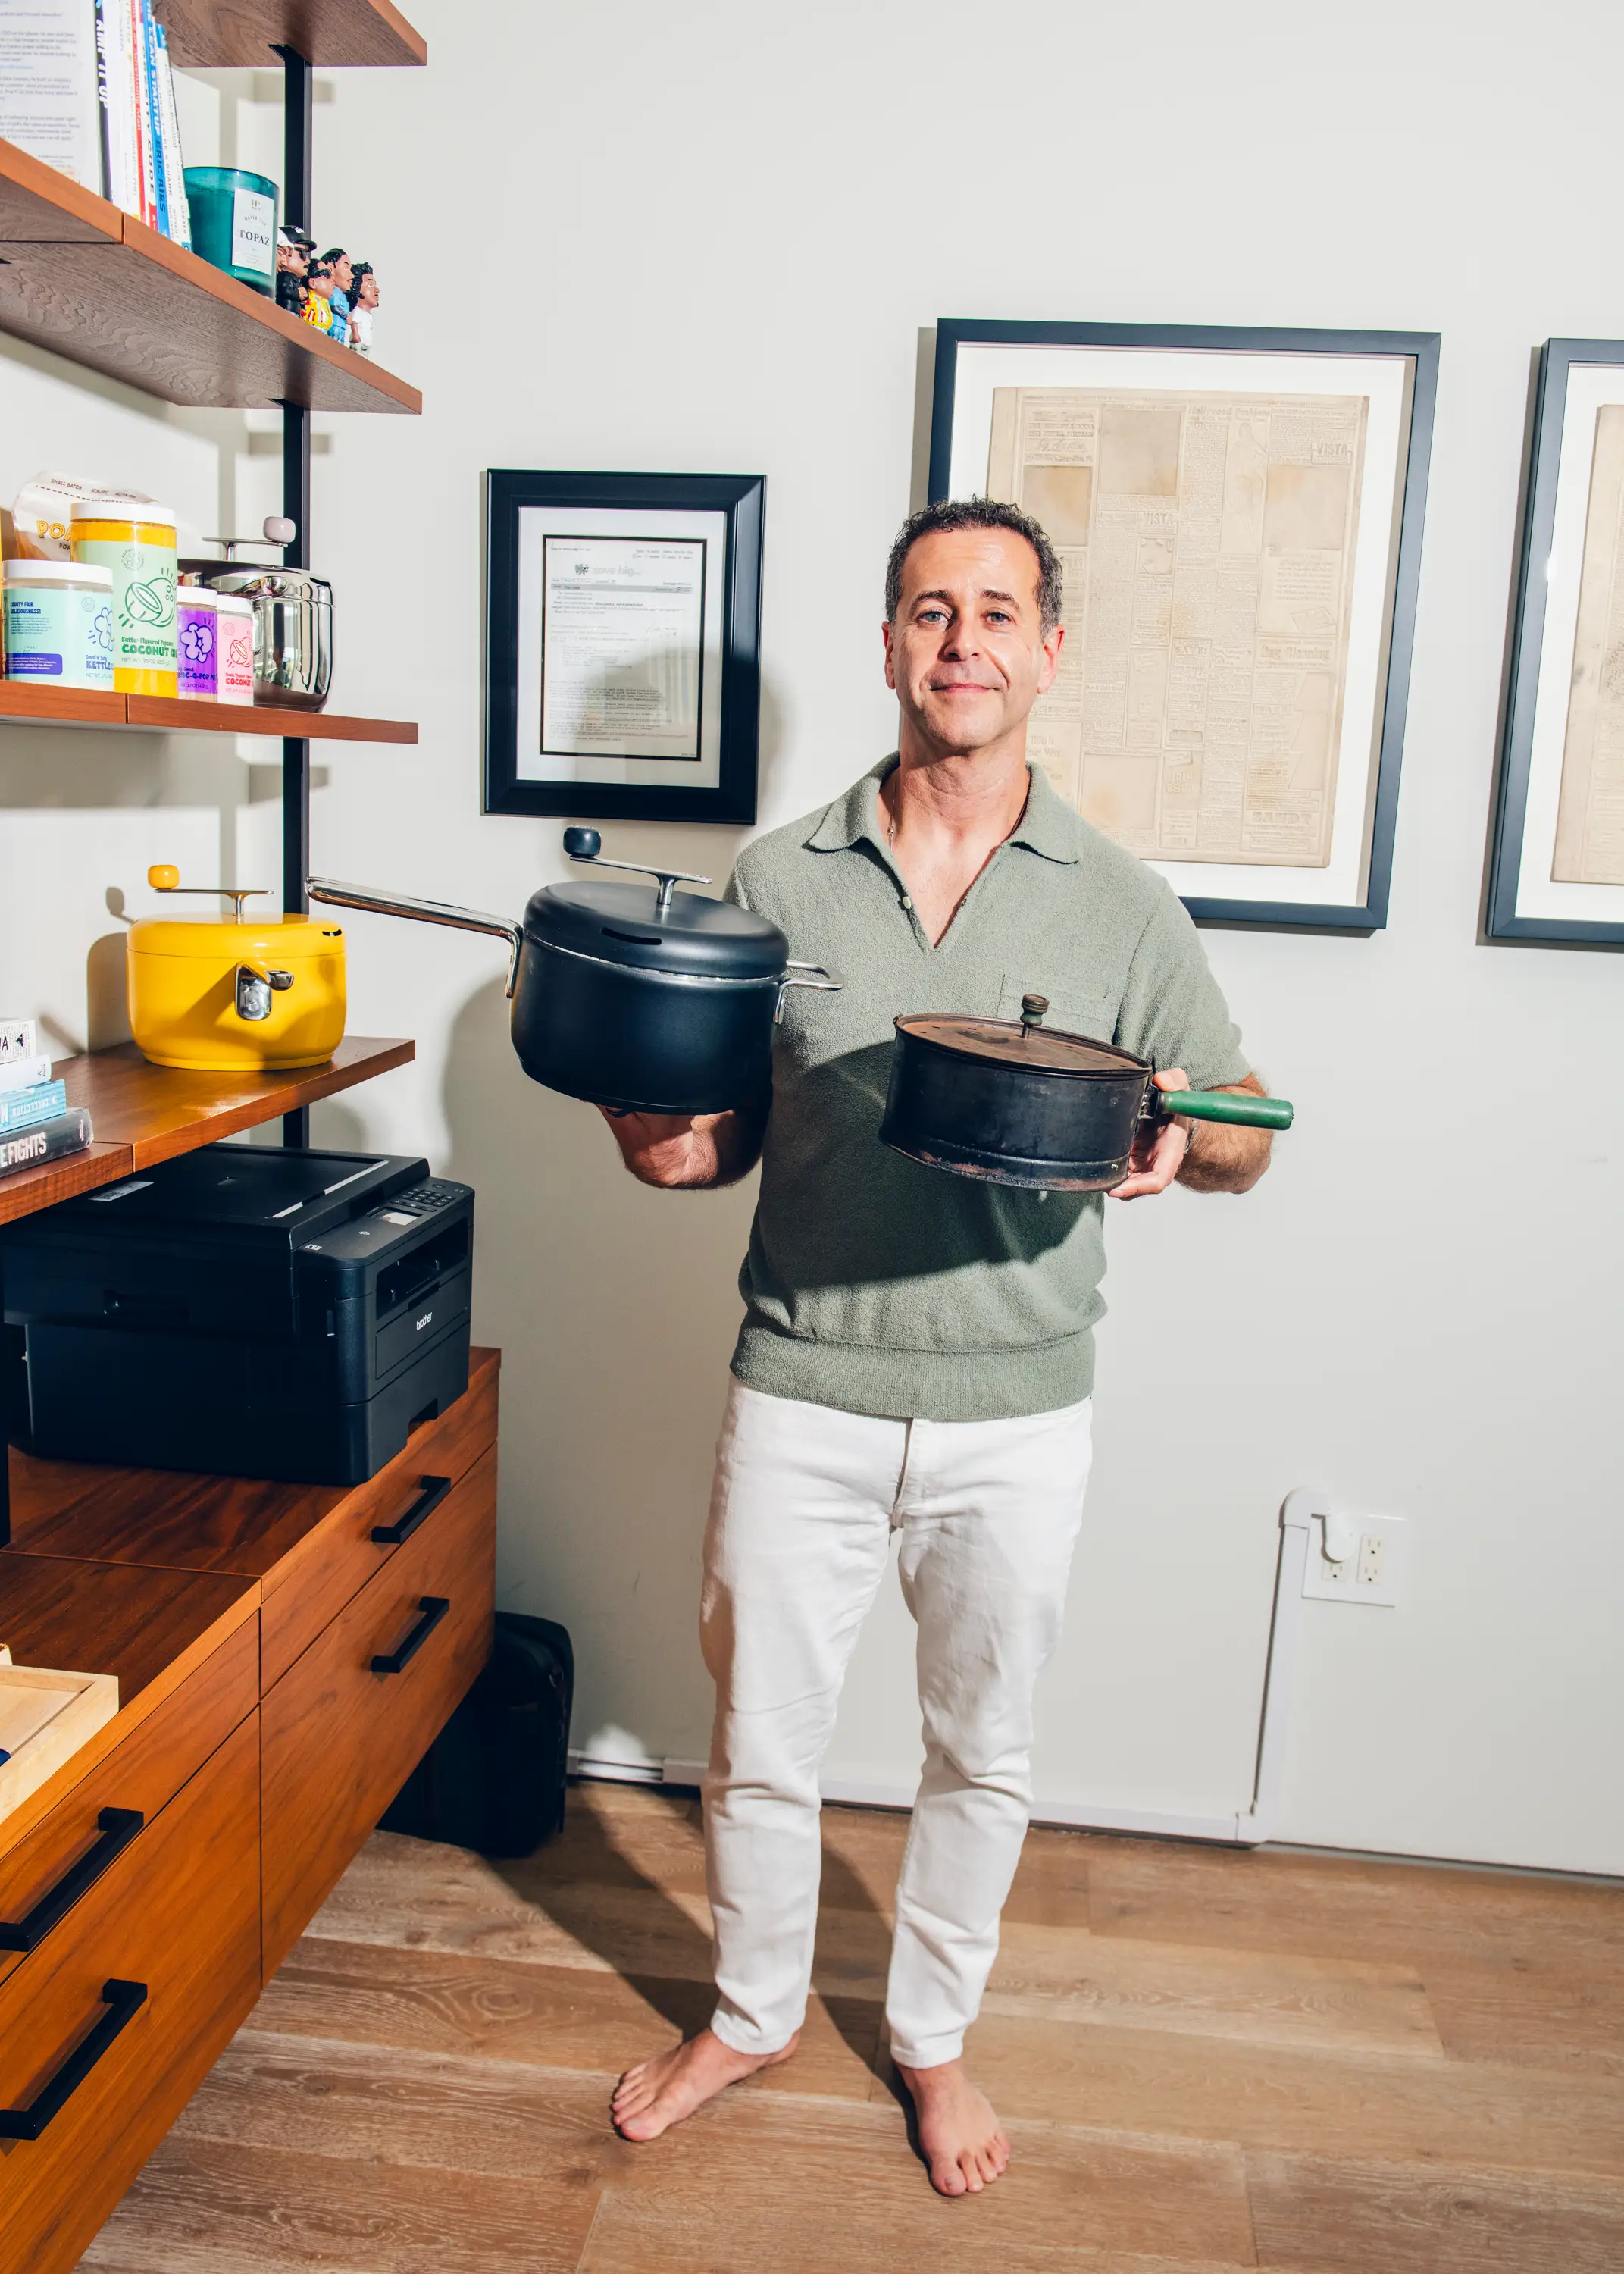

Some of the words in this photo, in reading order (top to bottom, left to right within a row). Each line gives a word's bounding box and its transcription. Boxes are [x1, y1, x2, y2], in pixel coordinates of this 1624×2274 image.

[96, 19, 105, 60] AMP
[98, 64, 106, 80] IT
[99, 85, 108, 108] UP
[151, 69, 161, 136] STARTUP
[155, 139, 164, 175] ERIC
[158, 178, 166, 212] RIES
[238, 229, 270, 246] TOPAZ
[1316, 442, 1348, 456] VISTA
[51, 478, 66, 487] SMALL
[67, 482, 82, 490] BATCH
[1143, 512, 1174, 526] VISTA
[121, 644, 170, 657] COCONUT
[86, 660, 111, 671] KETTLE
[177, 672, 209, 680] OC-O-POP
[225, 677, 252, 687] COCONUT
[12, 1097, 49, 1117] COLLECTION
[7, 1132, 47, 1165] FIGHTS
[416, 1311, 433, 1331] brother
